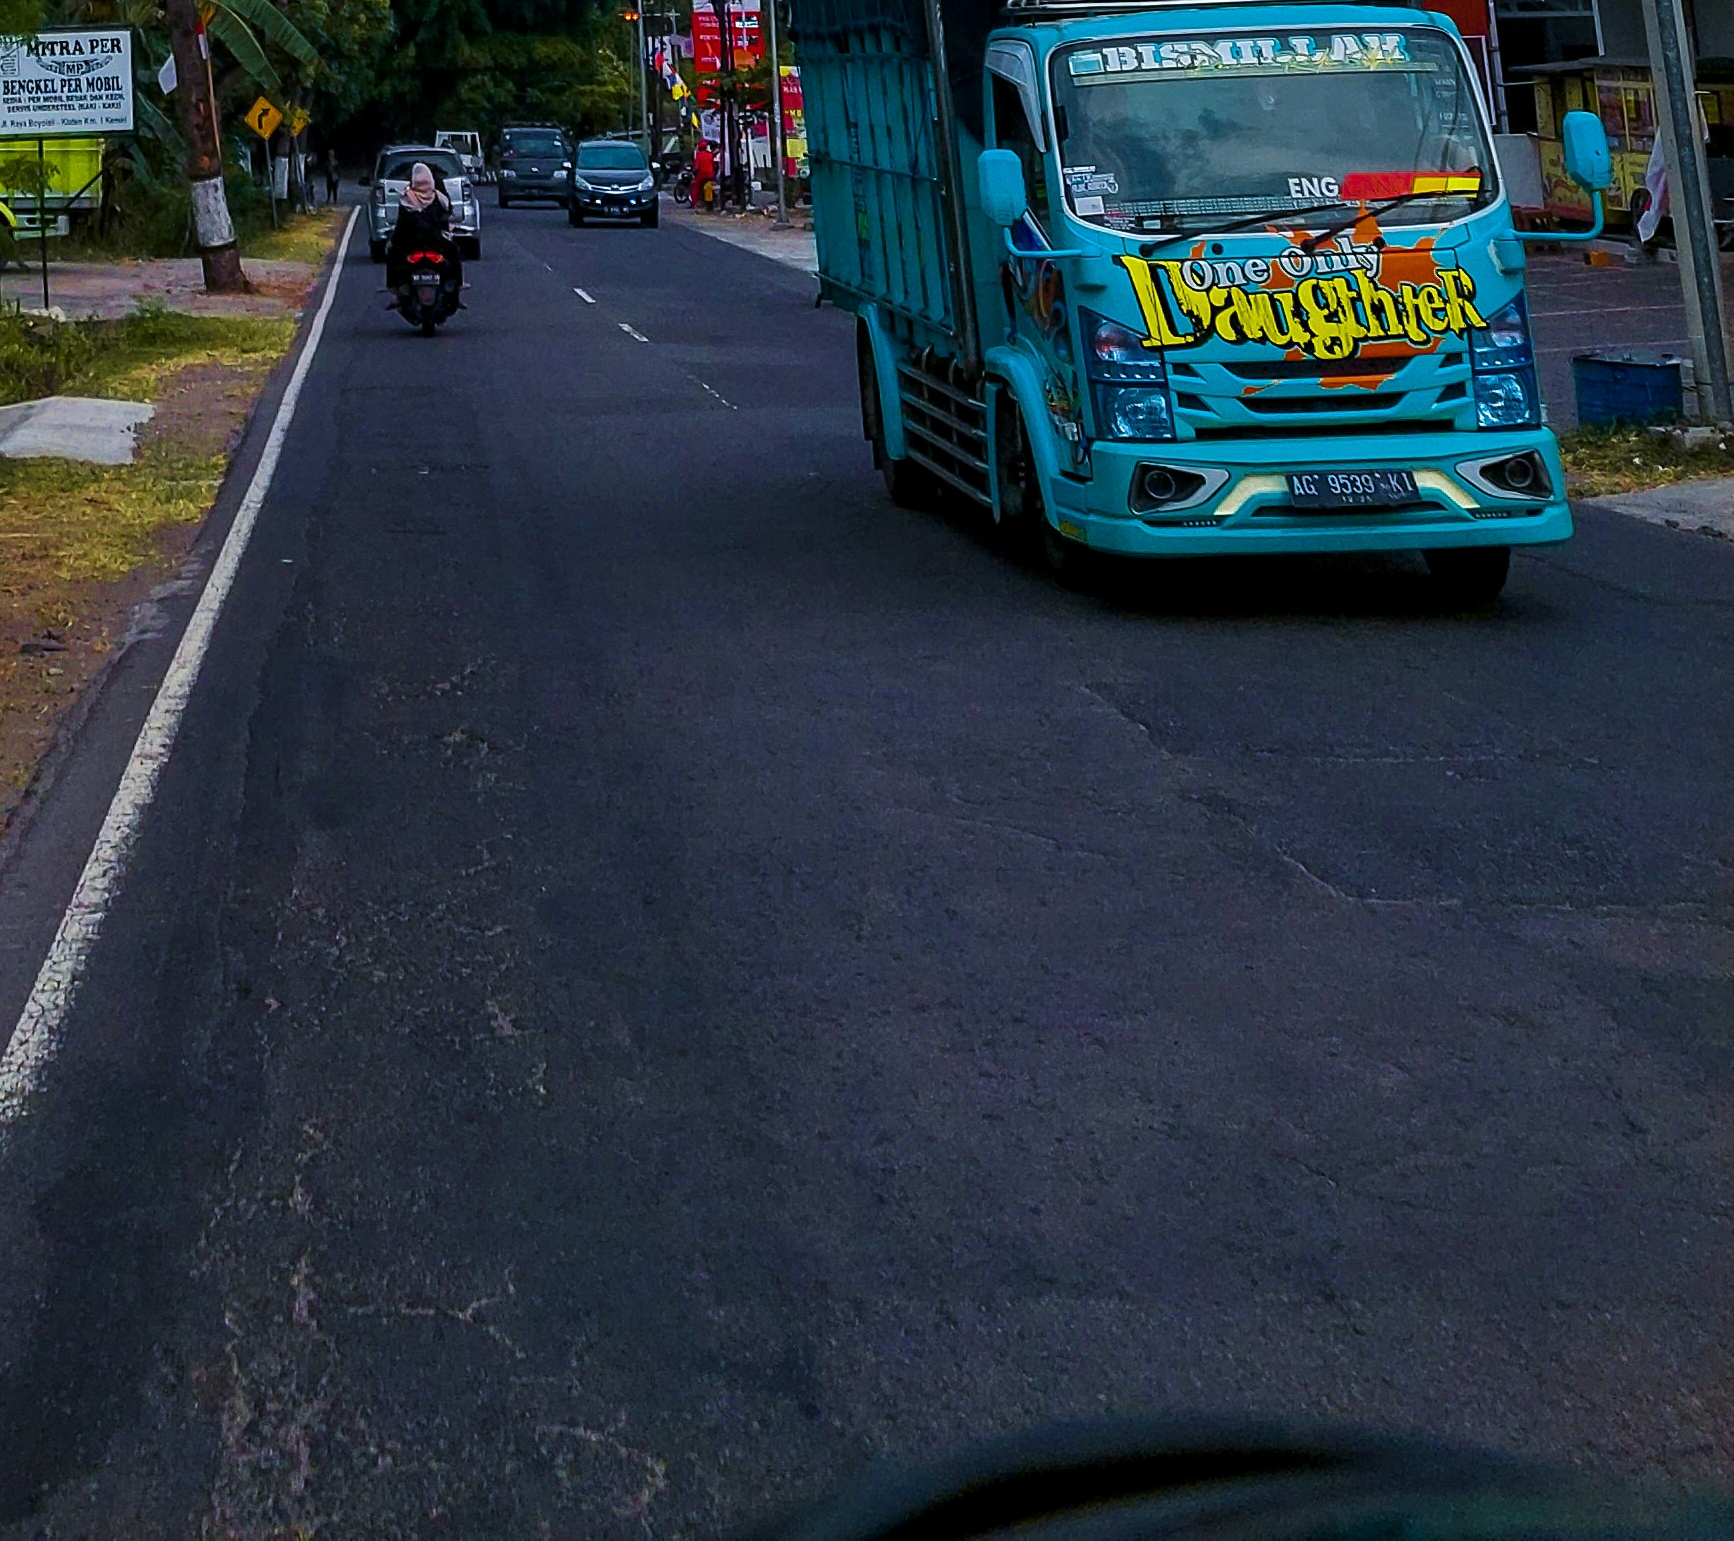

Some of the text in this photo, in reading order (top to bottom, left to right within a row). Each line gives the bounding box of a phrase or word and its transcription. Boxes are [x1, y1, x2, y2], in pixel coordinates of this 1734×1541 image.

[88, 37, 123, 55] PER
[1102, 33, 1412, 73] BISMILLAH
[66, 63, 84, 75] MP
[2, 75, 123, 96] BENGKEL PER MOBIL
[1287, 175, 1340, 199] ENG
[1180, 236, 1383, 291] One Only
[1292, 474, 1318, 496] AG
[1328, 473, 1375, 494] 9539
